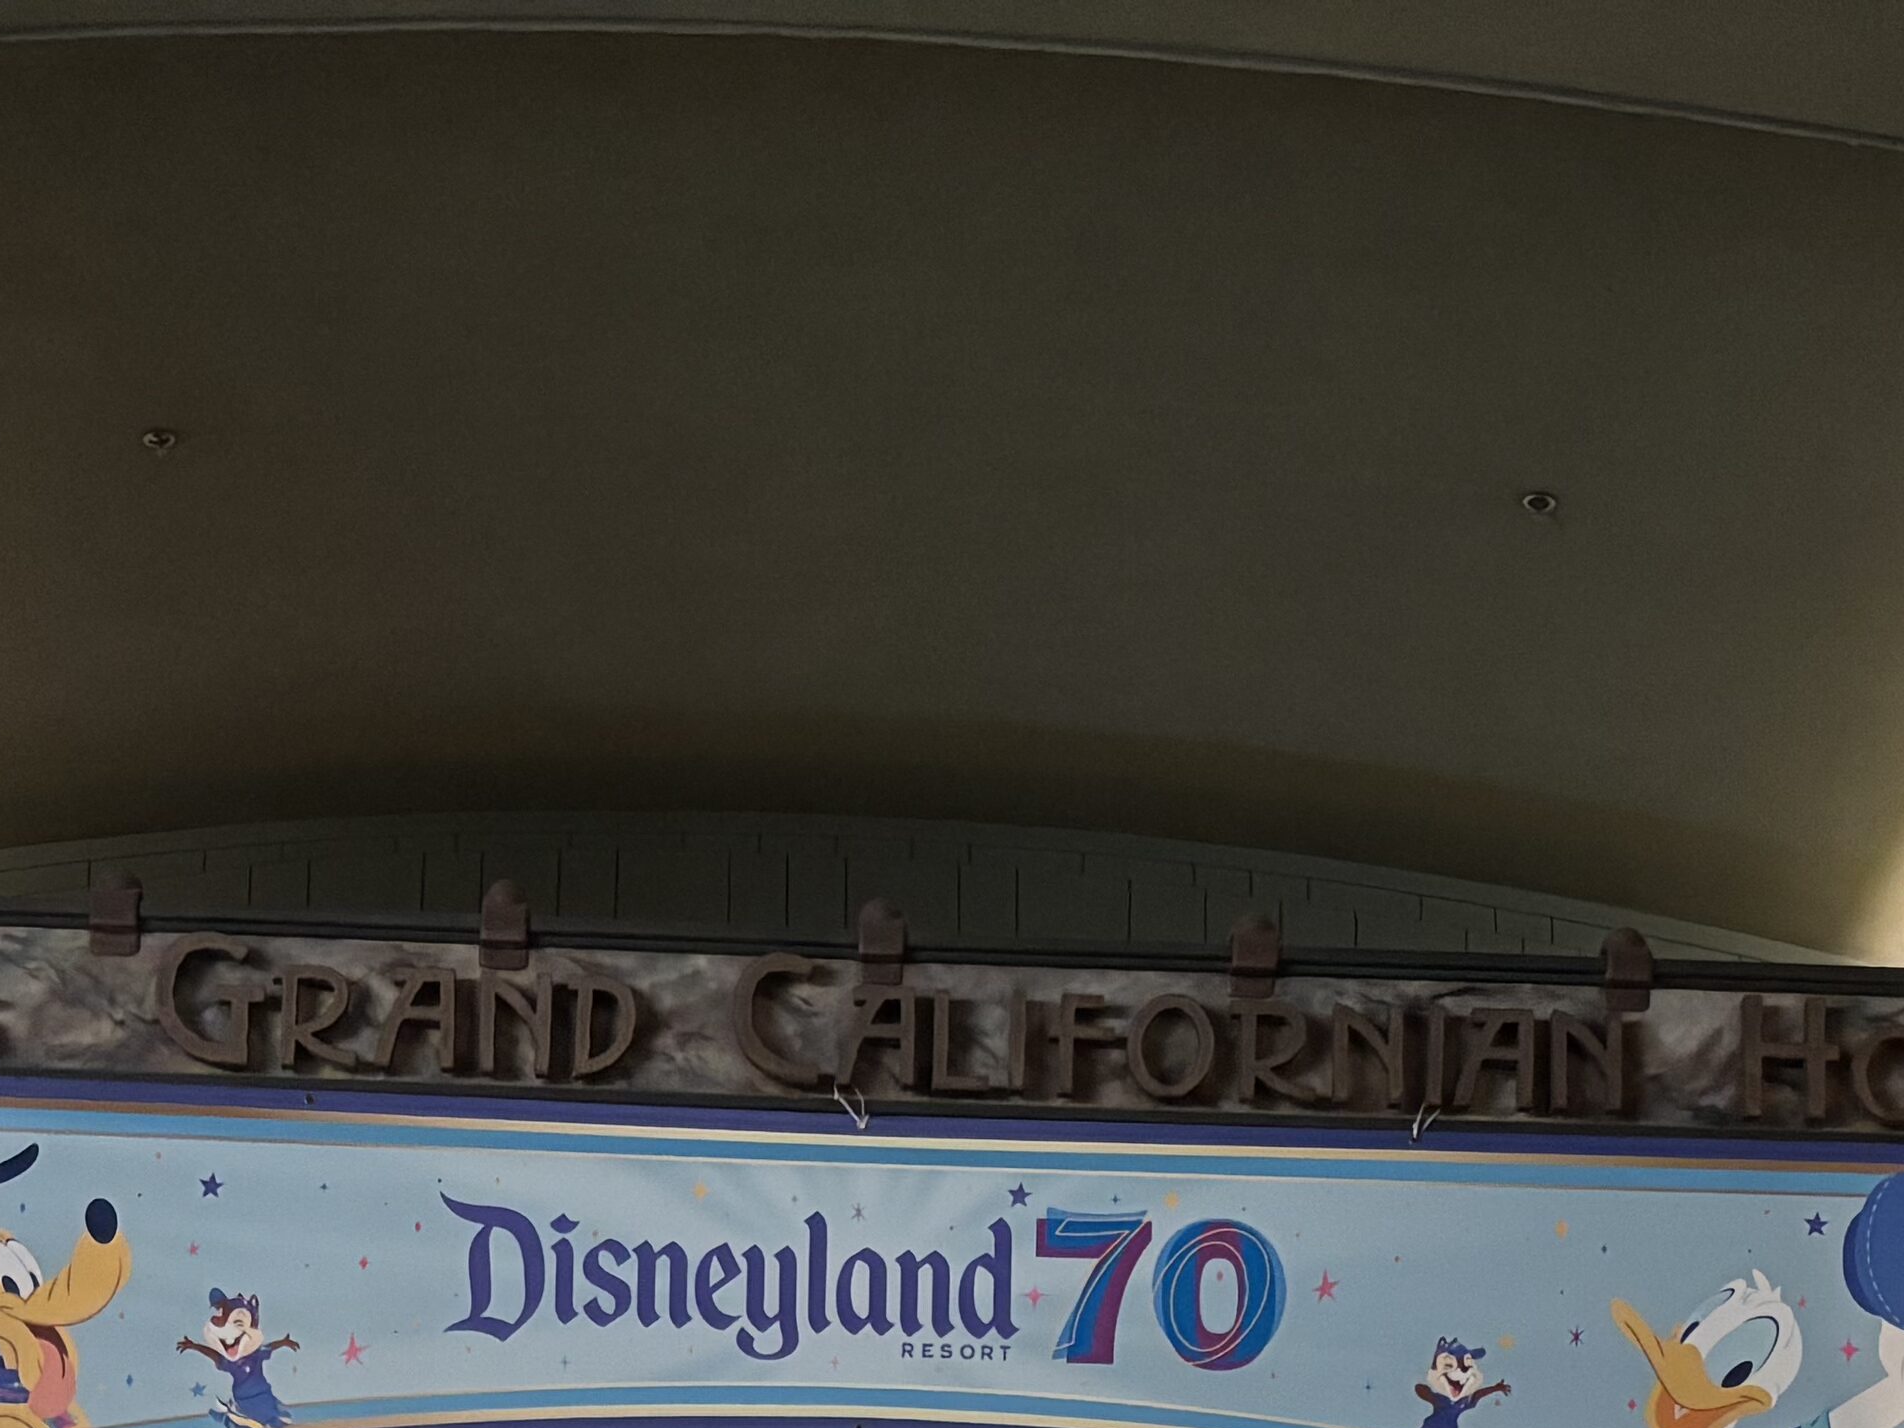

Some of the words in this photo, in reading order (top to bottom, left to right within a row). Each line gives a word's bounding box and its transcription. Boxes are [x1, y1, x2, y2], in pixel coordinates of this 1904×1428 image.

[439, 1190, 1021, 1361] Disneyland
[1035, 1206, 1287, 1371] 70
[900, 1342, 1012, 1361] RESORT
